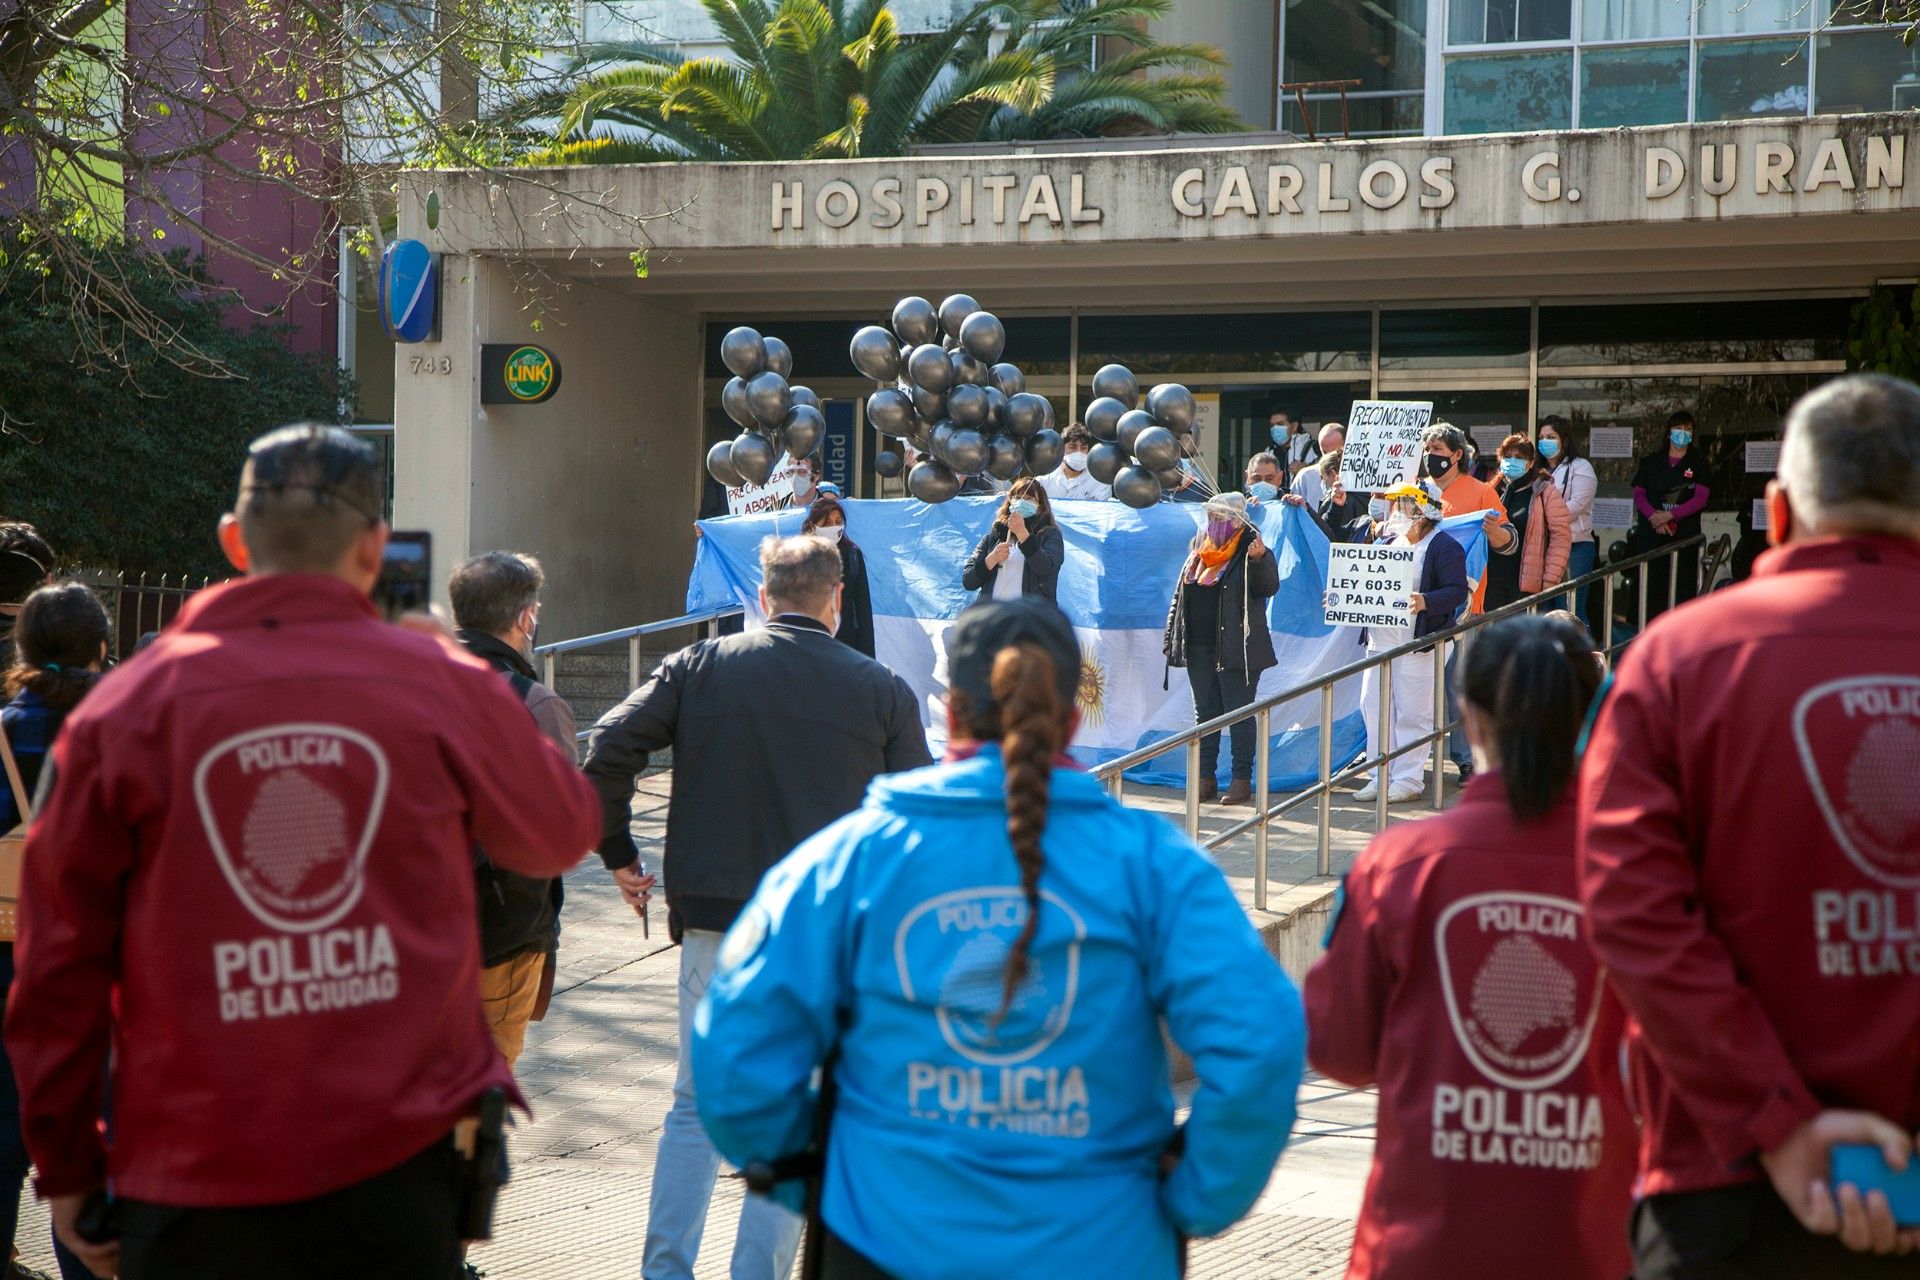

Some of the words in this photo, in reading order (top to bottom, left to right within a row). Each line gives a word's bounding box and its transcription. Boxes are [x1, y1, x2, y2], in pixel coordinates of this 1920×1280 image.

[771, 173, 1103, 229] HOSPITAL
[1171, 156, 1455, 217] CARLOS
[1521, 151, 1580, 202] G.
[1646, 134, 1905, 200] DURAN
[410, 355, 453, 376] 743
[508, 361, 550, 382] LINK
[1343, 443, 1370, 458] EXTRAS
[1403, 444, 1416, 457] AL
[1360, 432, 1369, 440] DE
[1379, 431, 1393, 440] LAS
[1397, 428, 1422, 442] HORAS
[827, 434, 846, 497] udad
[1387, 461, 1404, 470] DEL
[1332, 548, 1414, 561] INCLUSIÓN
[1349, 563, 1359, 572] A
[1367, 564, 1387, 573] LA
[1331, 578, 1359, 589] LEY
[1365, 580, 1401, 591] 6035
[1346, 594, 1385, 606] PARA
[1326, 610, 1409, 626] ENFERMERÍA
[237, 737, 345, 774] POLICIA
[936, 898, 1026, 935] POLICI
[1477, 904, 1577, 940] POLICIA
[213, 923, 396, 991] POLICIA
[1818, 944, 1856, 976] DE
[1858, 943, 1902, 976] LA
[220, 987, 258, 1022] DE
[262, 985, 300, 1017] LA
[303, 971, 398, 1012] CIUDAD
[908, 1061, 1089, 1113] POLICIA
[1432, 1083, 1603, 1141] POLICIA
[1432, 1130, 1467, 1160] DE
[1471, 1133, 1507, 1164] LA
